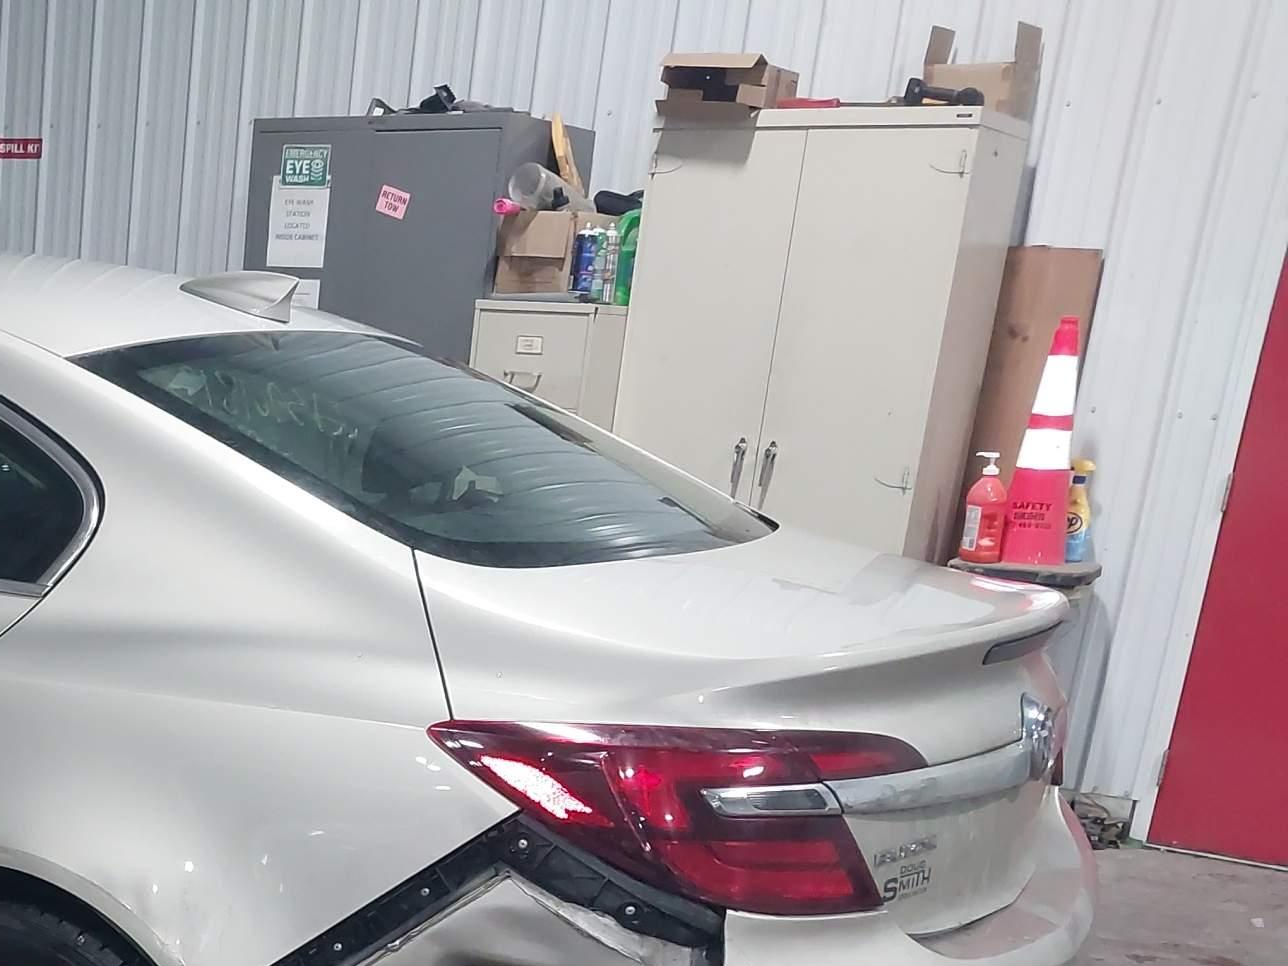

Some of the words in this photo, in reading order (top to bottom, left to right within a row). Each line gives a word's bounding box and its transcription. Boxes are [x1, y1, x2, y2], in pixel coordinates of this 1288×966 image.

[0, 143, 25, 153] SPILL
[286, 160, 310, 174] EYE
[285, 175, 309, 183] WASH
[381, 190, 407, 205] RETURN
[384, 200, 400, 212] TOW
[1011, 501, 1053, 511] SAFETY
[883, 867, 931, 902] SMITH
